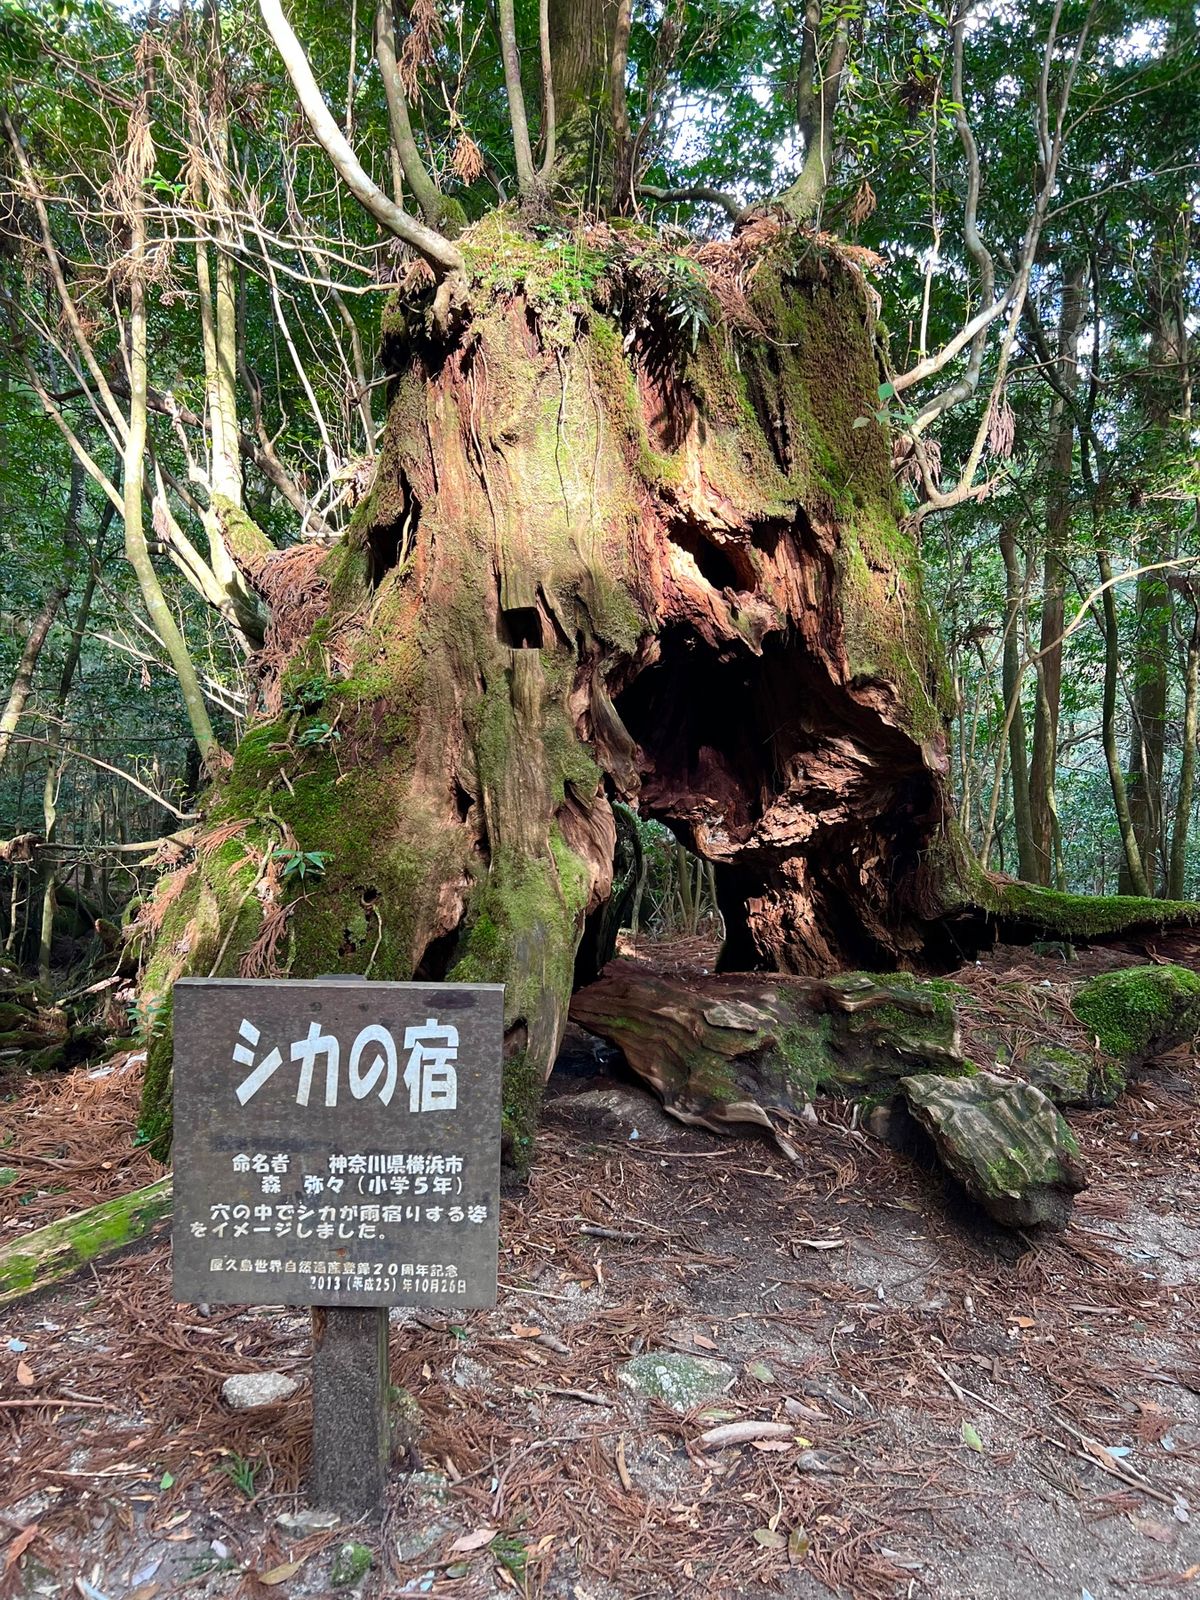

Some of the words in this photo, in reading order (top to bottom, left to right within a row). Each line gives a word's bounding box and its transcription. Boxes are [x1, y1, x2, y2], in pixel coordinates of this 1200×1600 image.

[232, 1018, 459, 1112] シカの宿
[232, 1154, 290, 1174] 命名者
[328, 1154, 464, 1174] 神奈川県横浜市
[261, 1176, 281, 1194] 森
[210, 1204, 488, 1223] 穴の中でシカが雨宿りする姿
[190, 1221, 388, 1240] をイメージしました。
